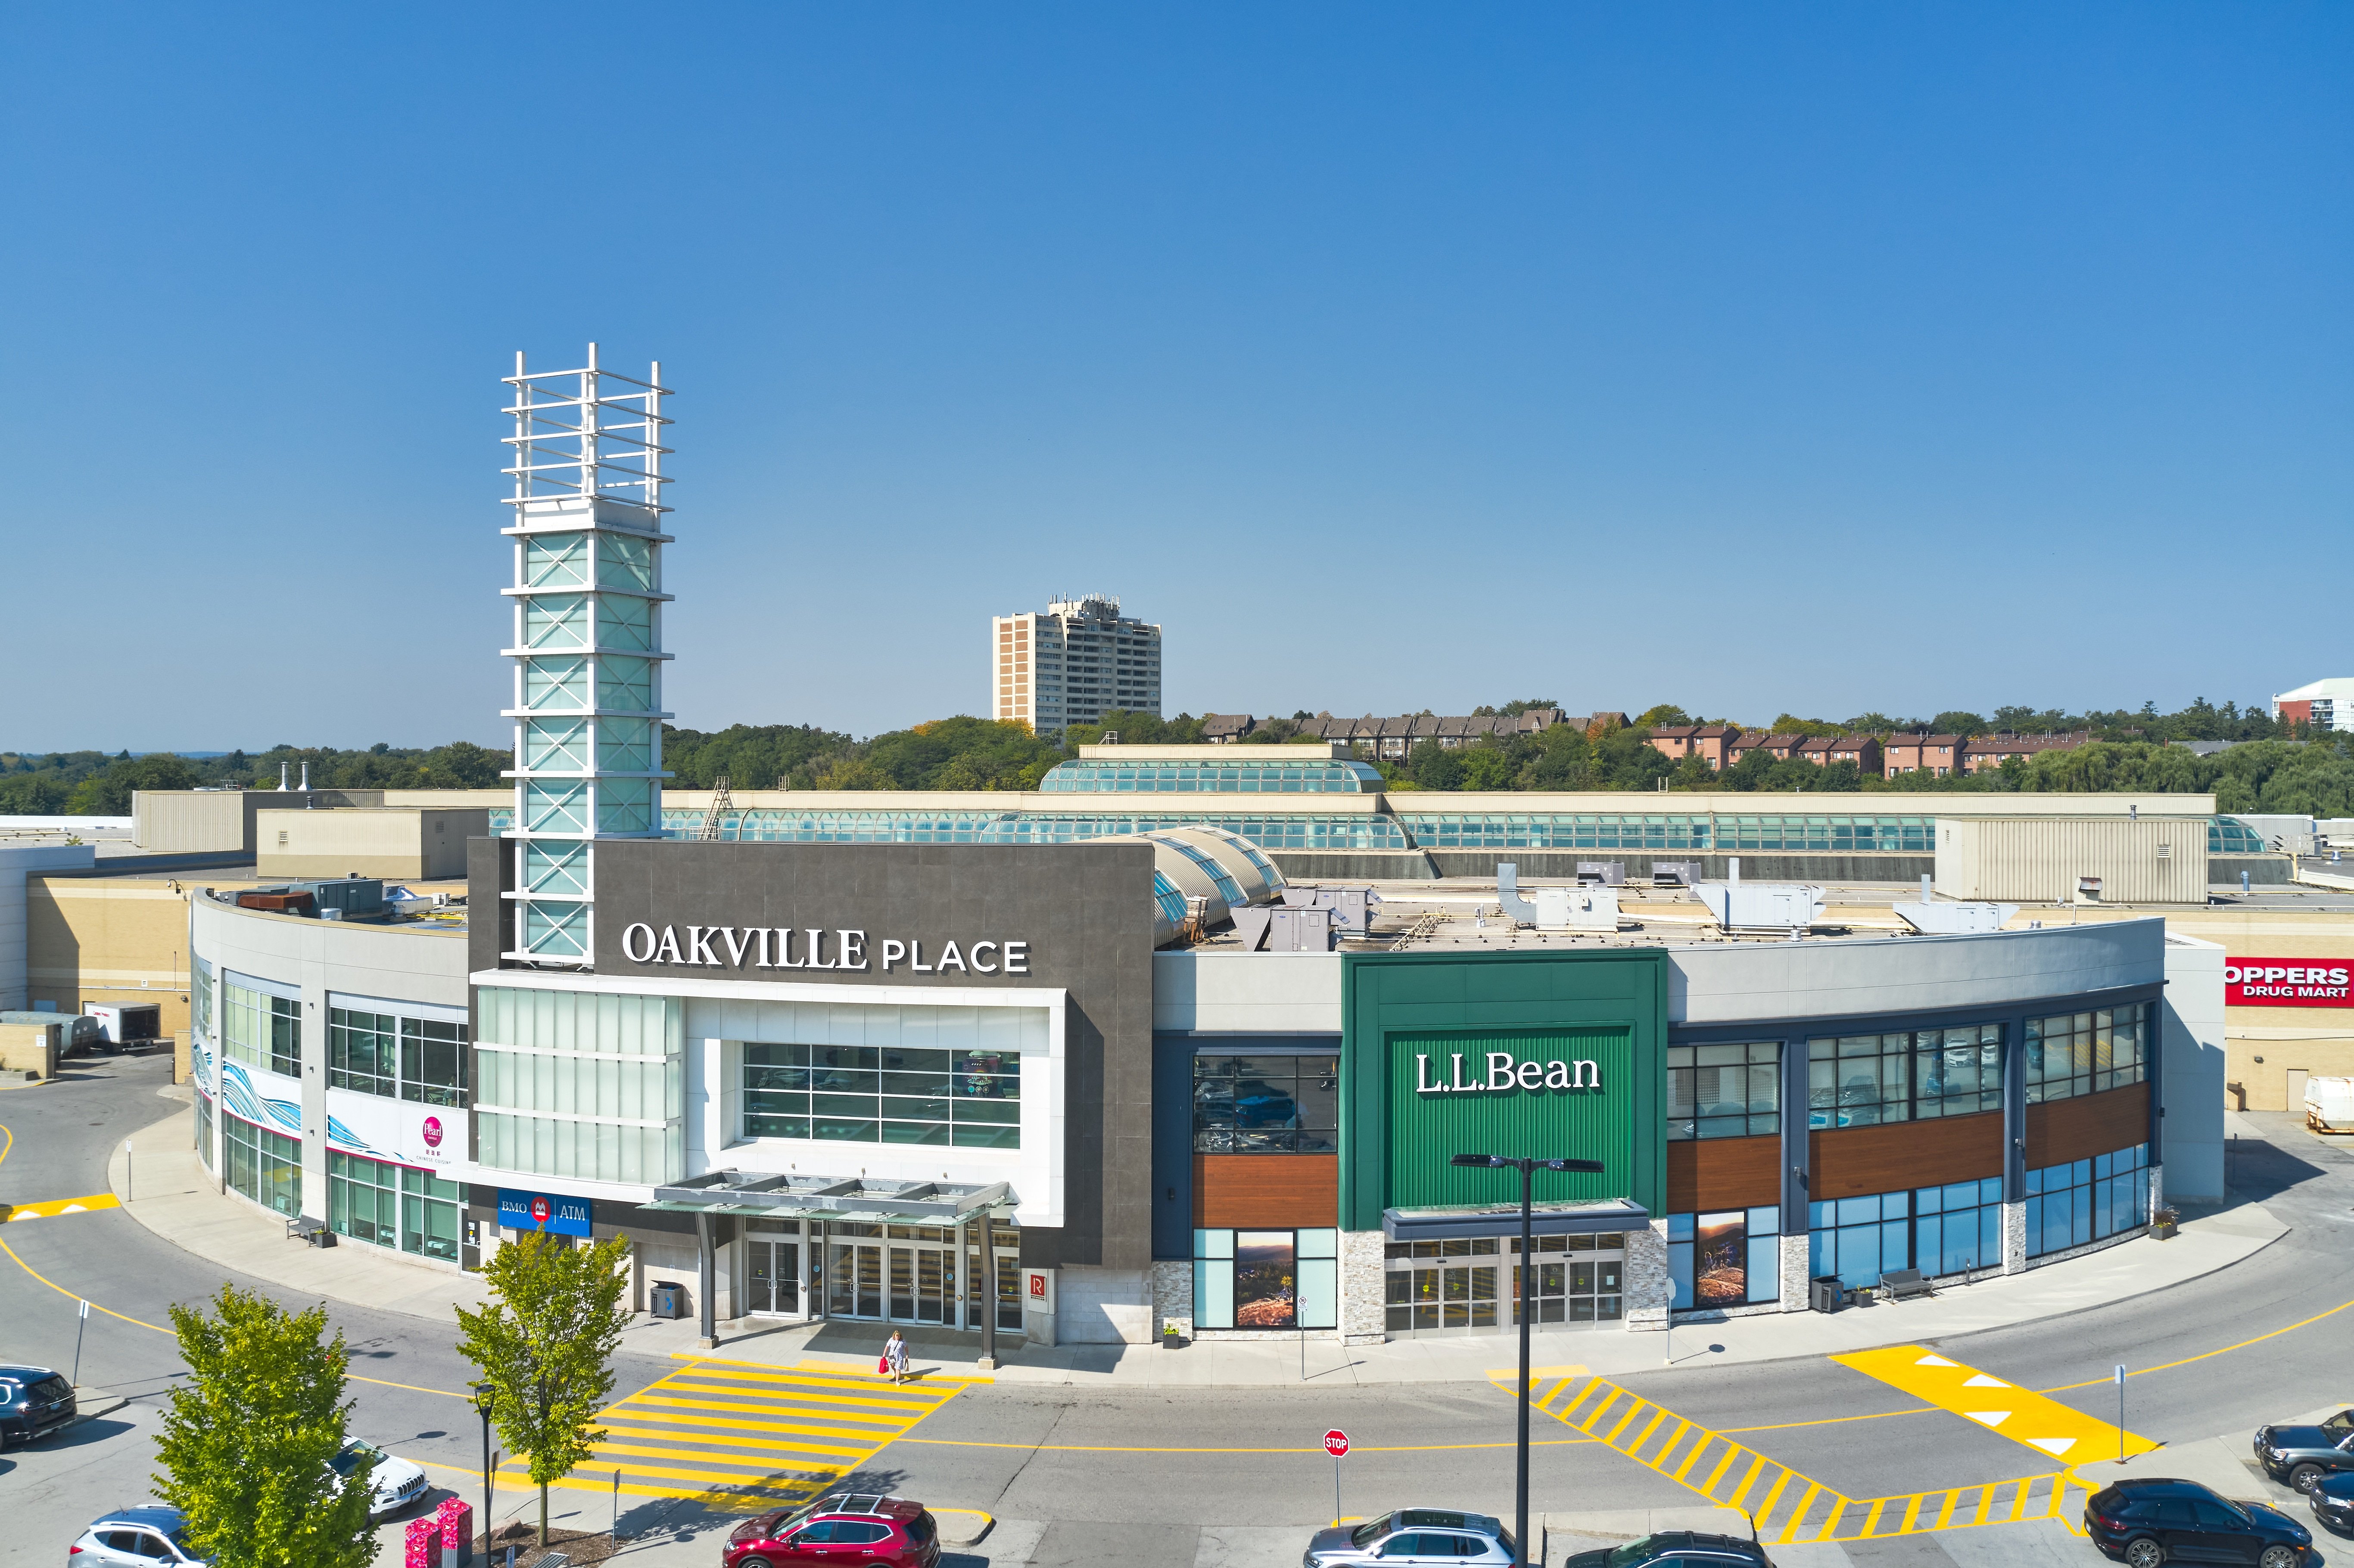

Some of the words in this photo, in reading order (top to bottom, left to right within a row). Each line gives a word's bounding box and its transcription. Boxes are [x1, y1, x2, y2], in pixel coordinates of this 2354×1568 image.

[622, 923, 868, 970] OAKVILLE
[882, 939, 1028, 972] PLACE
[2243, 986, 2293, 996] DRUG
[2298, 987, 2349, 997] MART
[1416, 1052, 1600, 1092] L.L.Bean
[423, 1123, 442, 1136] Pearl
[501, 1201, 527, 1213] BMO
[560, 1205, 585, 1221] ATM
[1326, 1437, 1347, 1449] STOP
